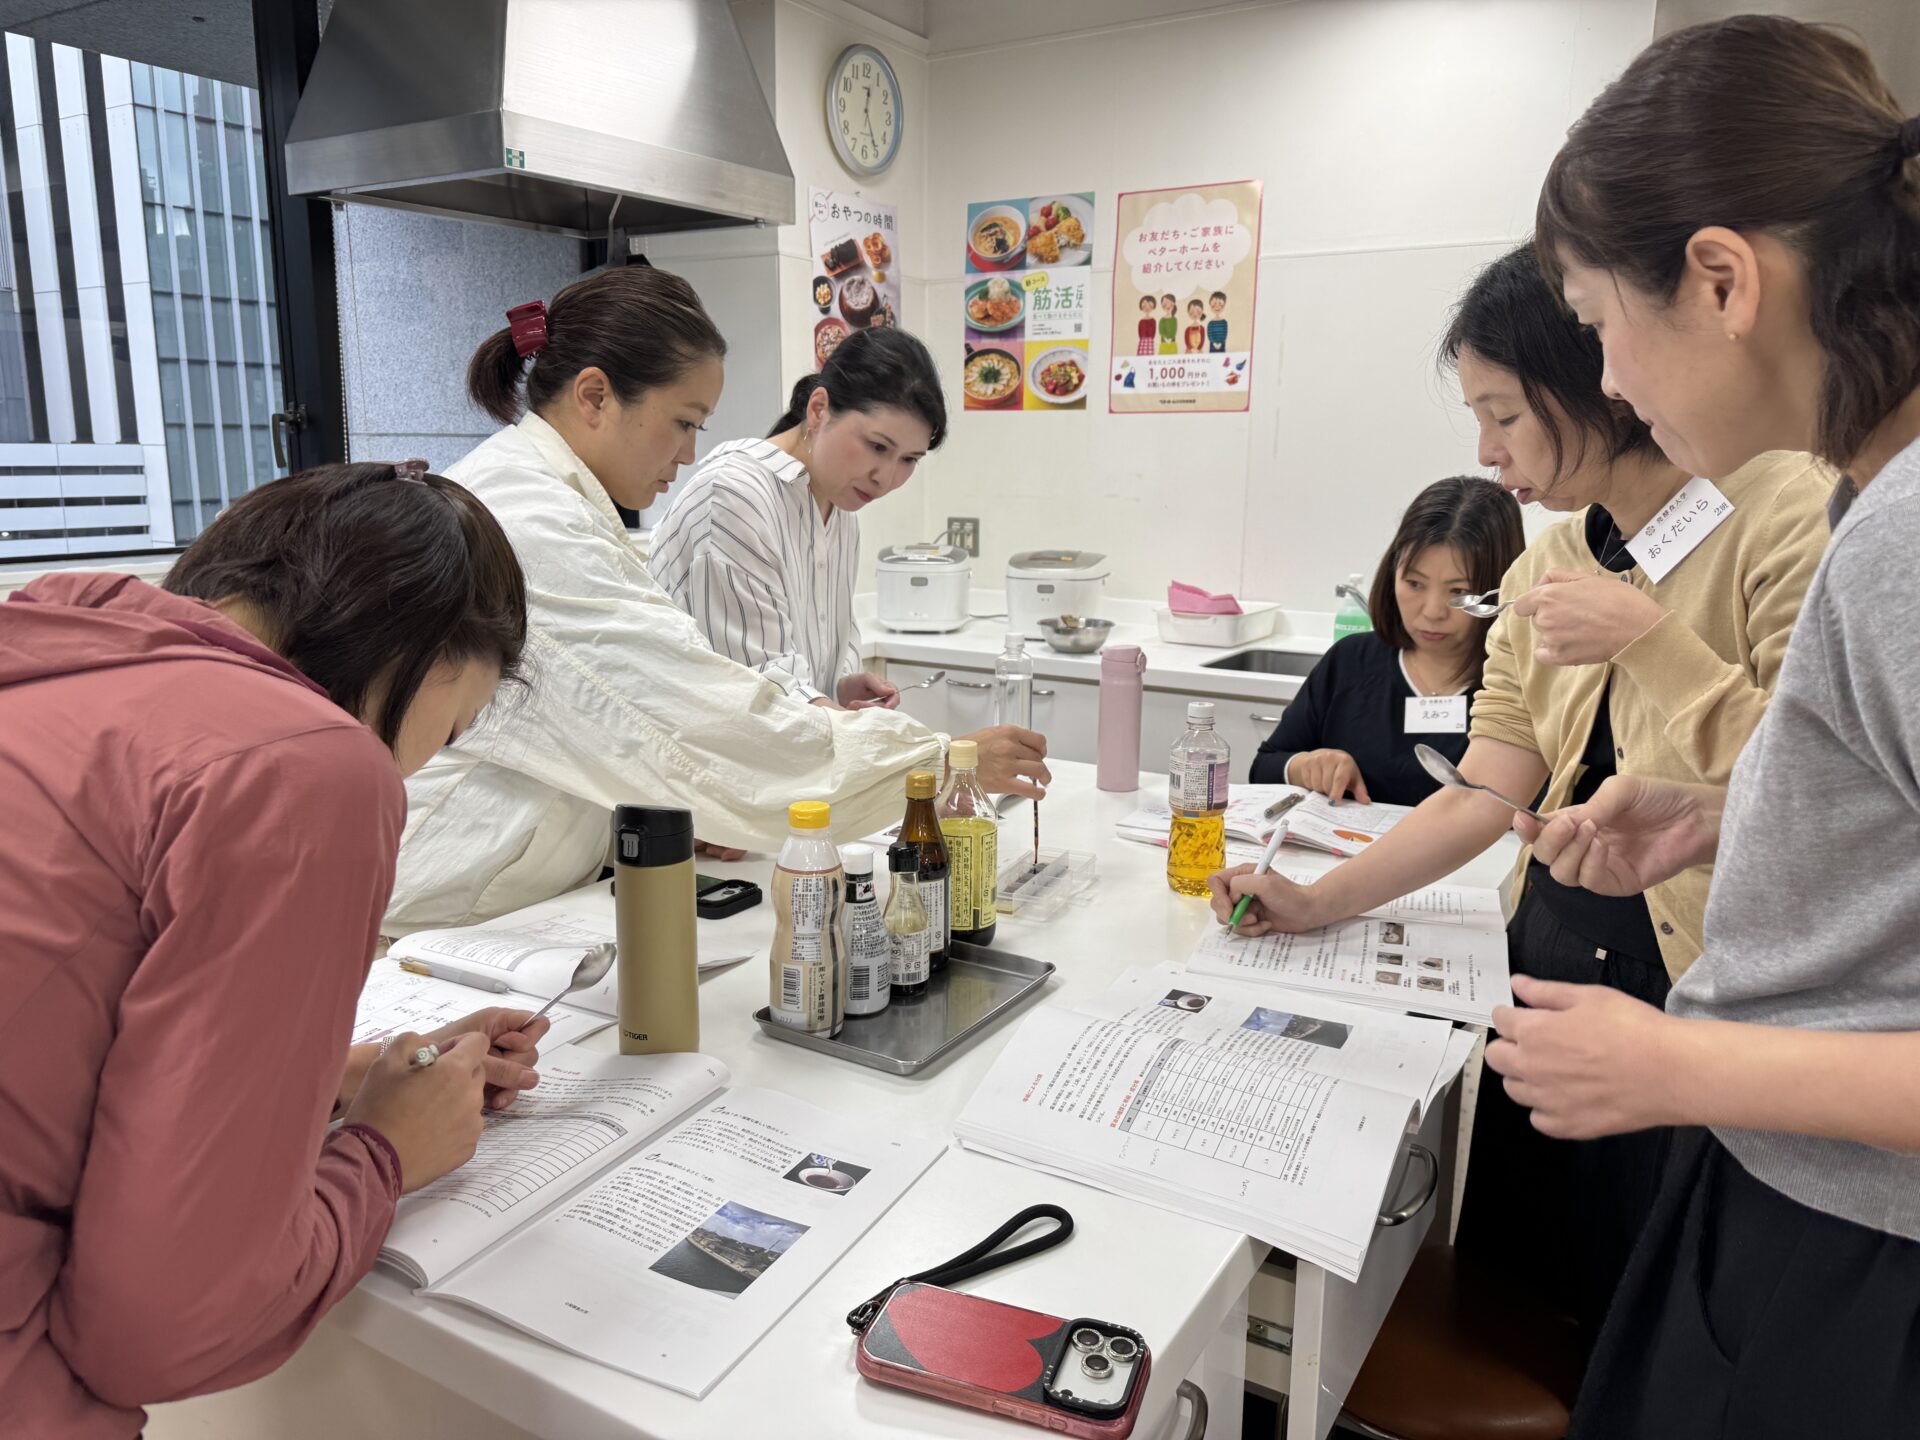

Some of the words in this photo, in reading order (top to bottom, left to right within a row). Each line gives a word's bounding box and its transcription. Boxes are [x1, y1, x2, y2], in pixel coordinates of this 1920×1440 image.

[851, 63, 859, 80] 11
[862, 62, 871, 79] 12
[843, 76, 852, 93] 10
[839, 97, 846, 113] 9
[882, 89, 889, 105] 2
[842, 119, 850, 135] 8
[885, 111, 892, 127] 3
[850, 137, 857, 152] 7
[861, 144, 868, 160] 6
[831, 203, 894, 231] おやつの時間
[1138, 225, 1234, 243] お友だち・ご家族に
[1142, 259, 1225, 274] 紹介してください
[1033, 286, 1074, 310] 筋活
[1648, 499, 1709, 559] おくだいら
[628, 1032, 648, 1041] TIGER
